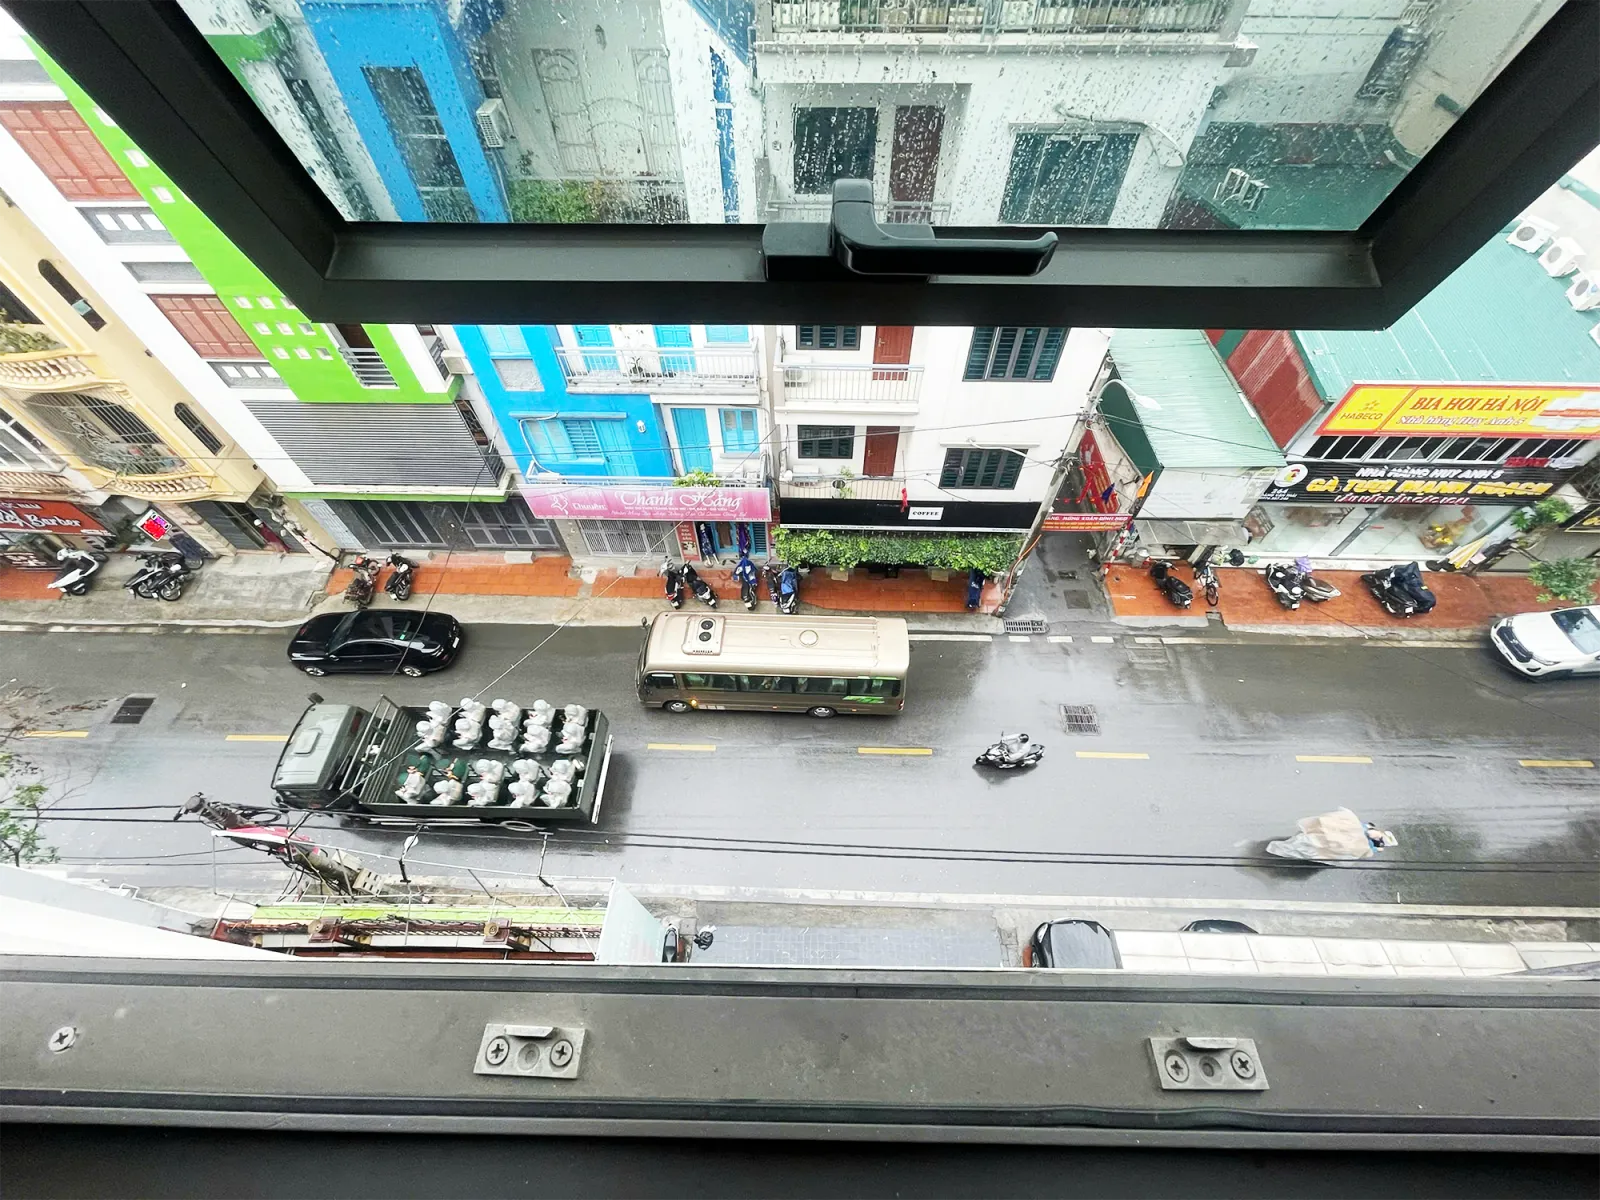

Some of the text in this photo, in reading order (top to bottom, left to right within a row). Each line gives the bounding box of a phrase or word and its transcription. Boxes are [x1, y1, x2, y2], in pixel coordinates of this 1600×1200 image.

[1410, 397, 1444, 410] BIA
[1478, 395, 1510, 411] HÀ
[1506, 396, 1548, 415] NỘI
[1340, 412, 1383, 420] HABECO
[1355, 465, 1388, 477] NHÀ
[1387, 466, 1430, 478] HÀNG
[1428, 469, 1462, 479] HUY
[1458, 469, 1494, 479] ANH
[1306, 476, 1340, 493] GÀ
[1395, 480, 1472, 496] MẠNH
[1467, 481, 1554, 497] HOẠCH
[614, 489, 674, 506] Thanh
[23, 513, 82, 527] Barber
